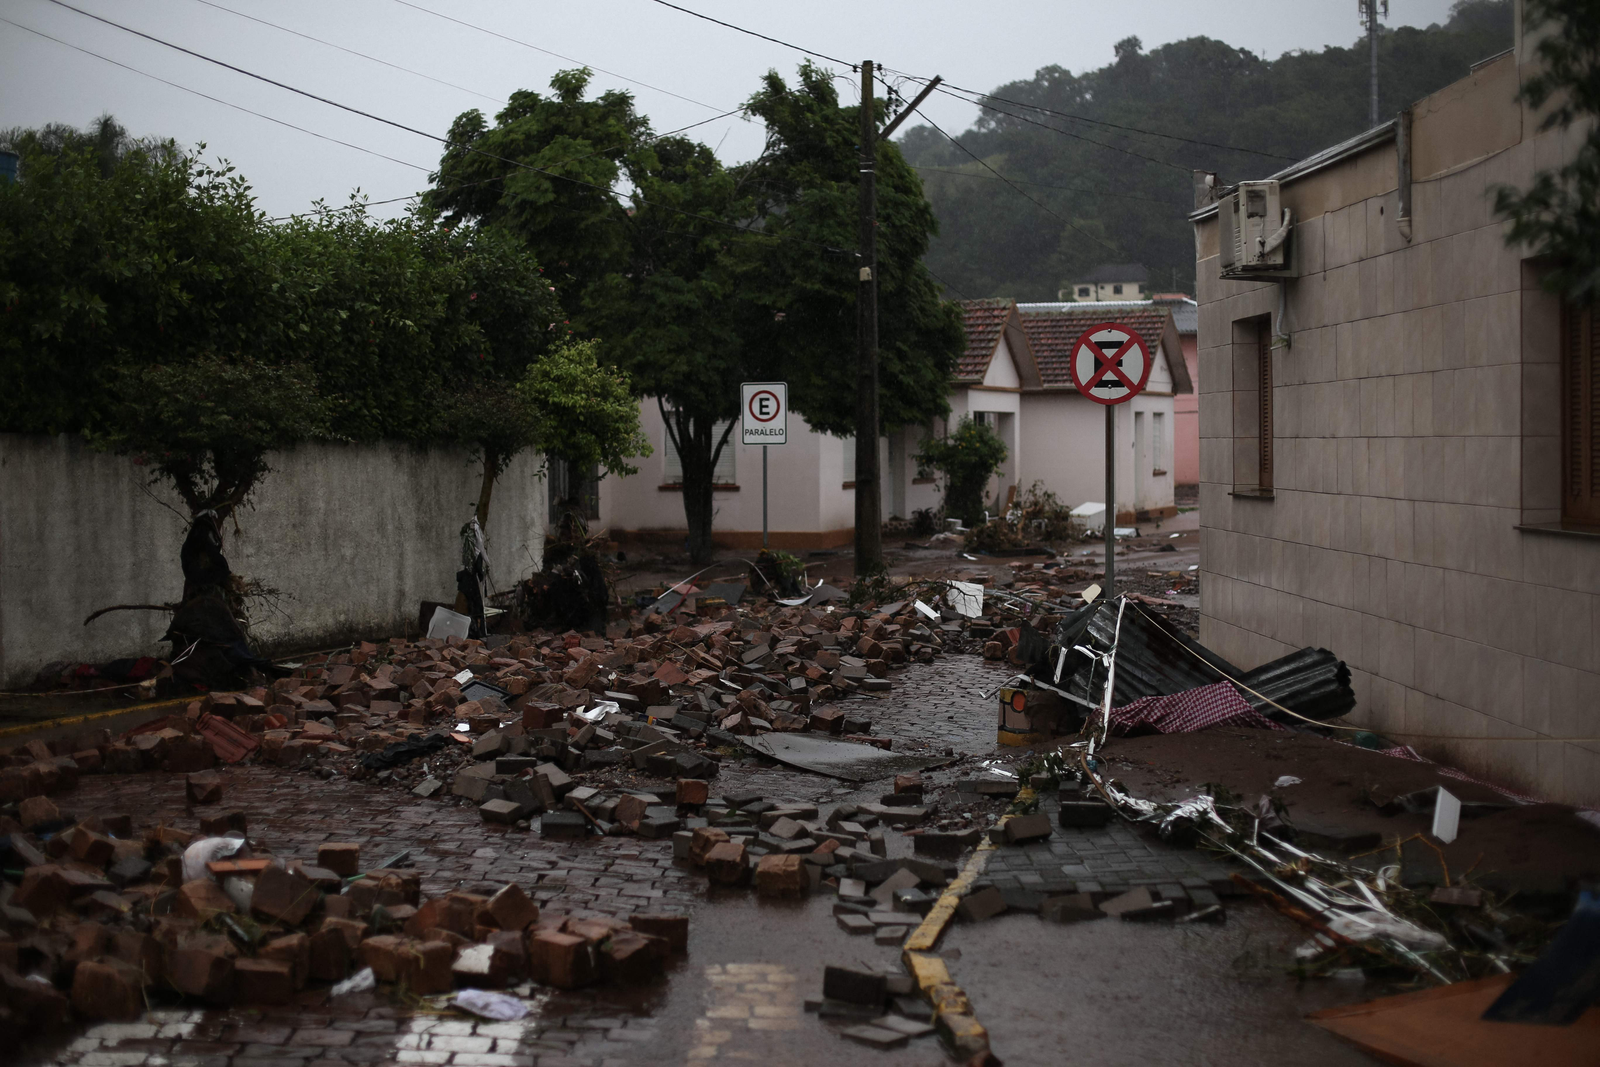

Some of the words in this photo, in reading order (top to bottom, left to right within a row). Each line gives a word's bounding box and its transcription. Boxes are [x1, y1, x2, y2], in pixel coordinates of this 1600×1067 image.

[1094, 341, 1125, 388] E
[759, 397, 770, 415] E
[745, 428, 784, 436] PARALELO
